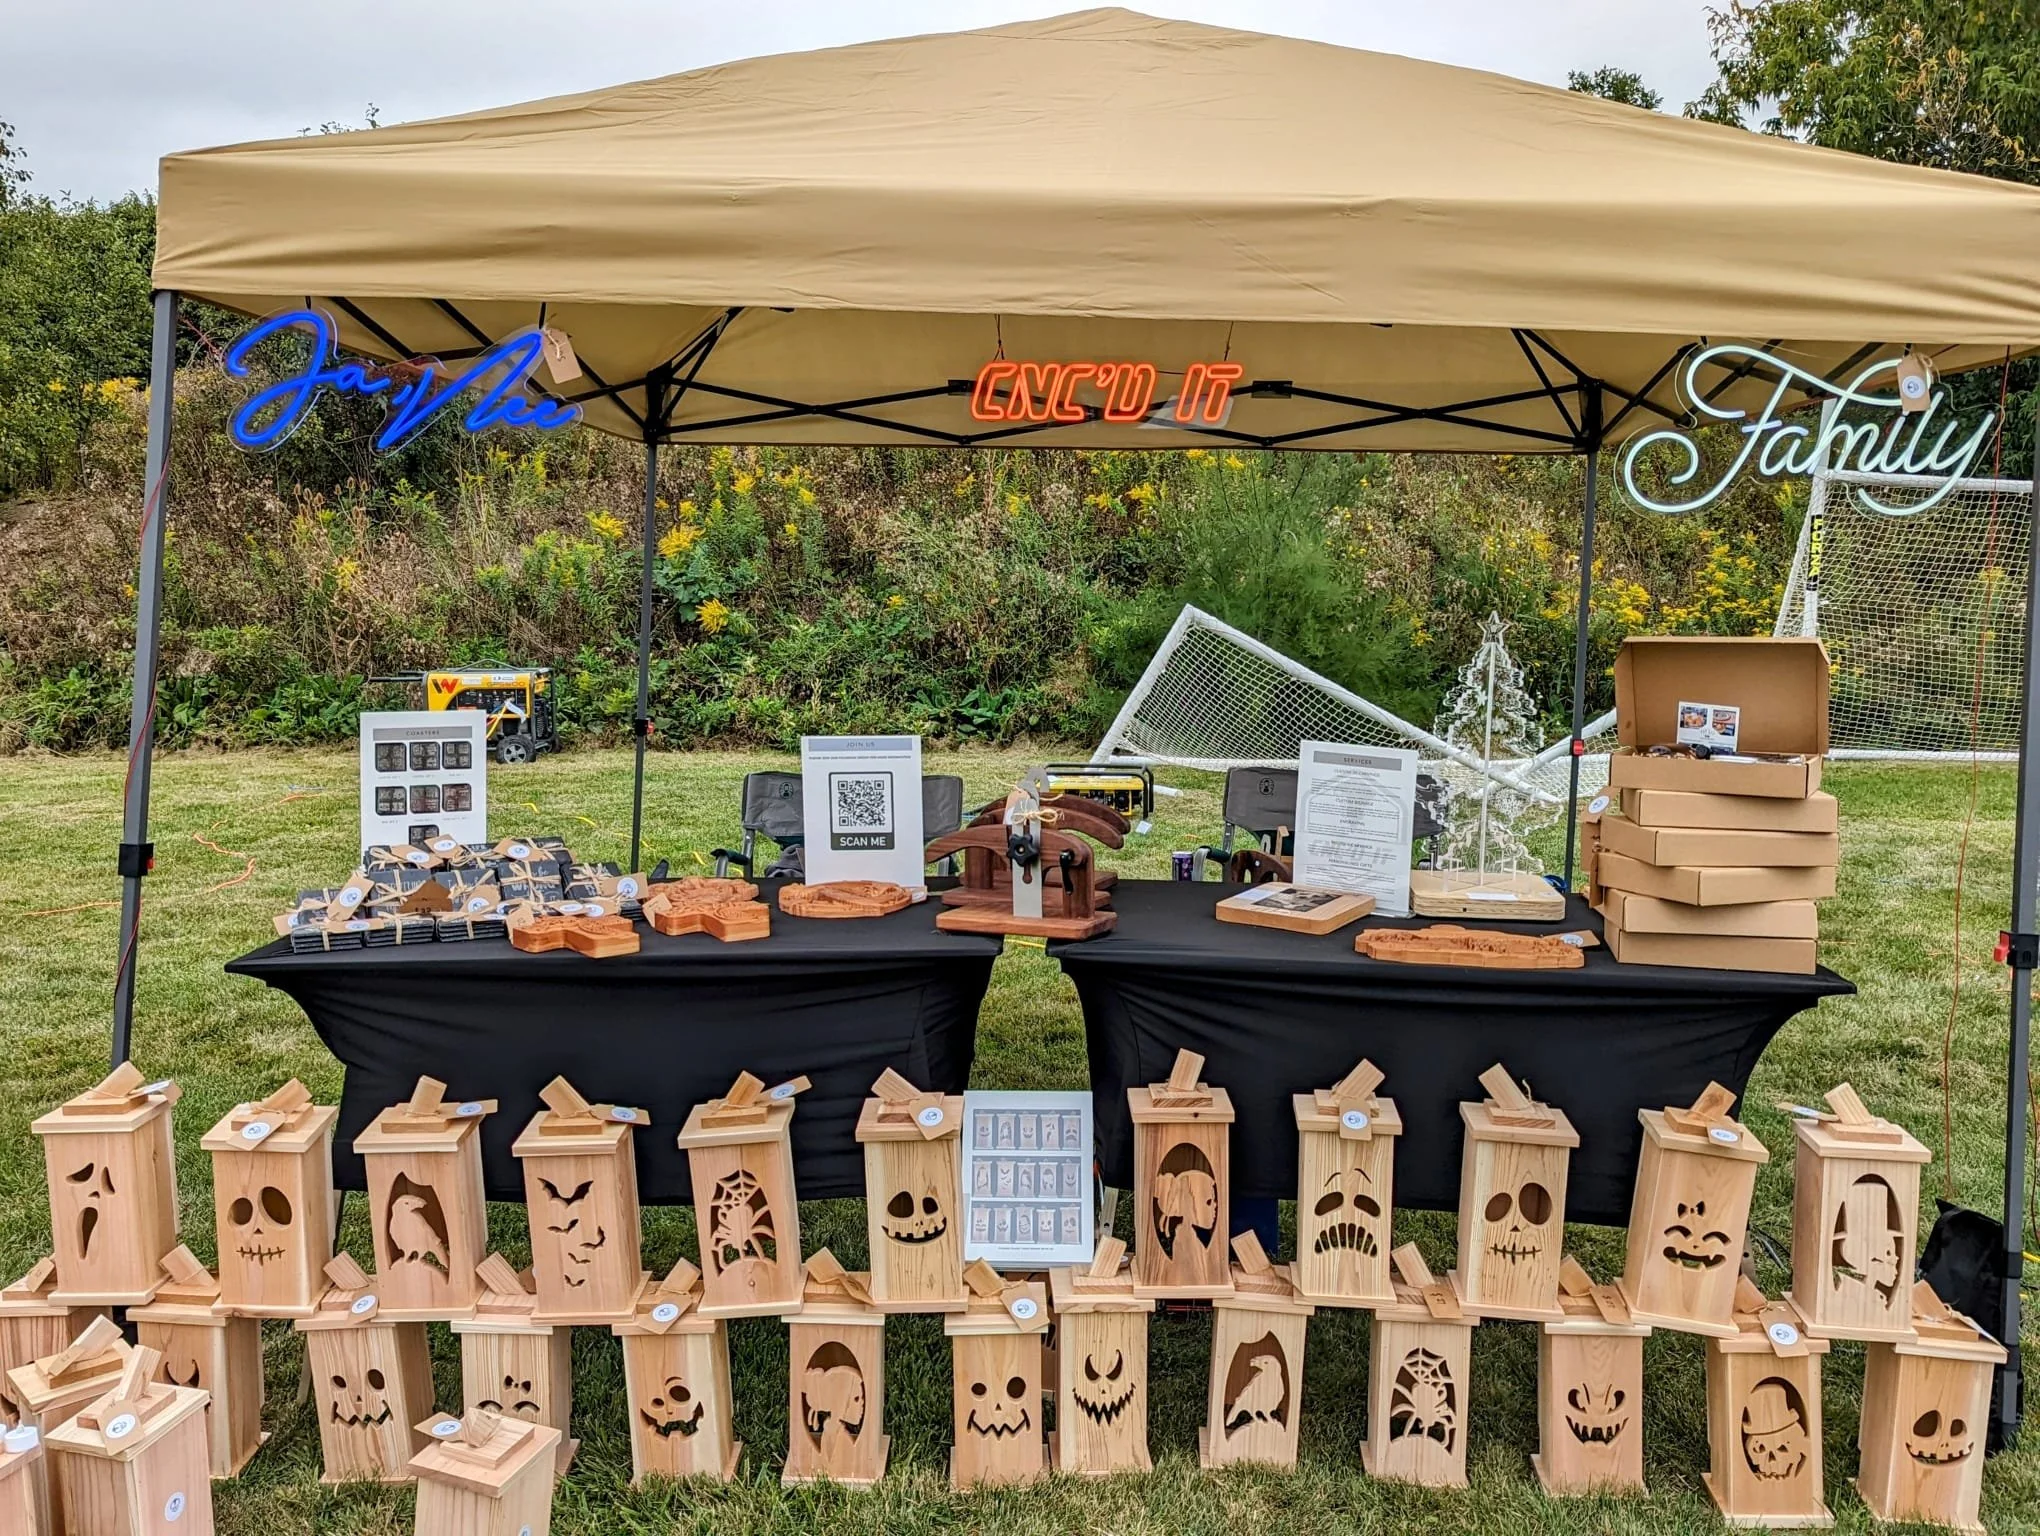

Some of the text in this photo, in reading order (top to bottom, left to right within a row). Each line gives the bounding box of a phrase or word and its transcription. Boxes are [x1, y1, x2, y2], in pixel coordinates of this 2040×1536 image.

[1174, 362, 1244, 422] IT
[1623, 344, 1996, 517] Family
[1808, 518, 1823, 577] FORZA
[406, 728, 440, 736] COASTERS
[1343, 756, 1373, 765] SERVICES
[839, 836, 887, 847] SCAN ME
